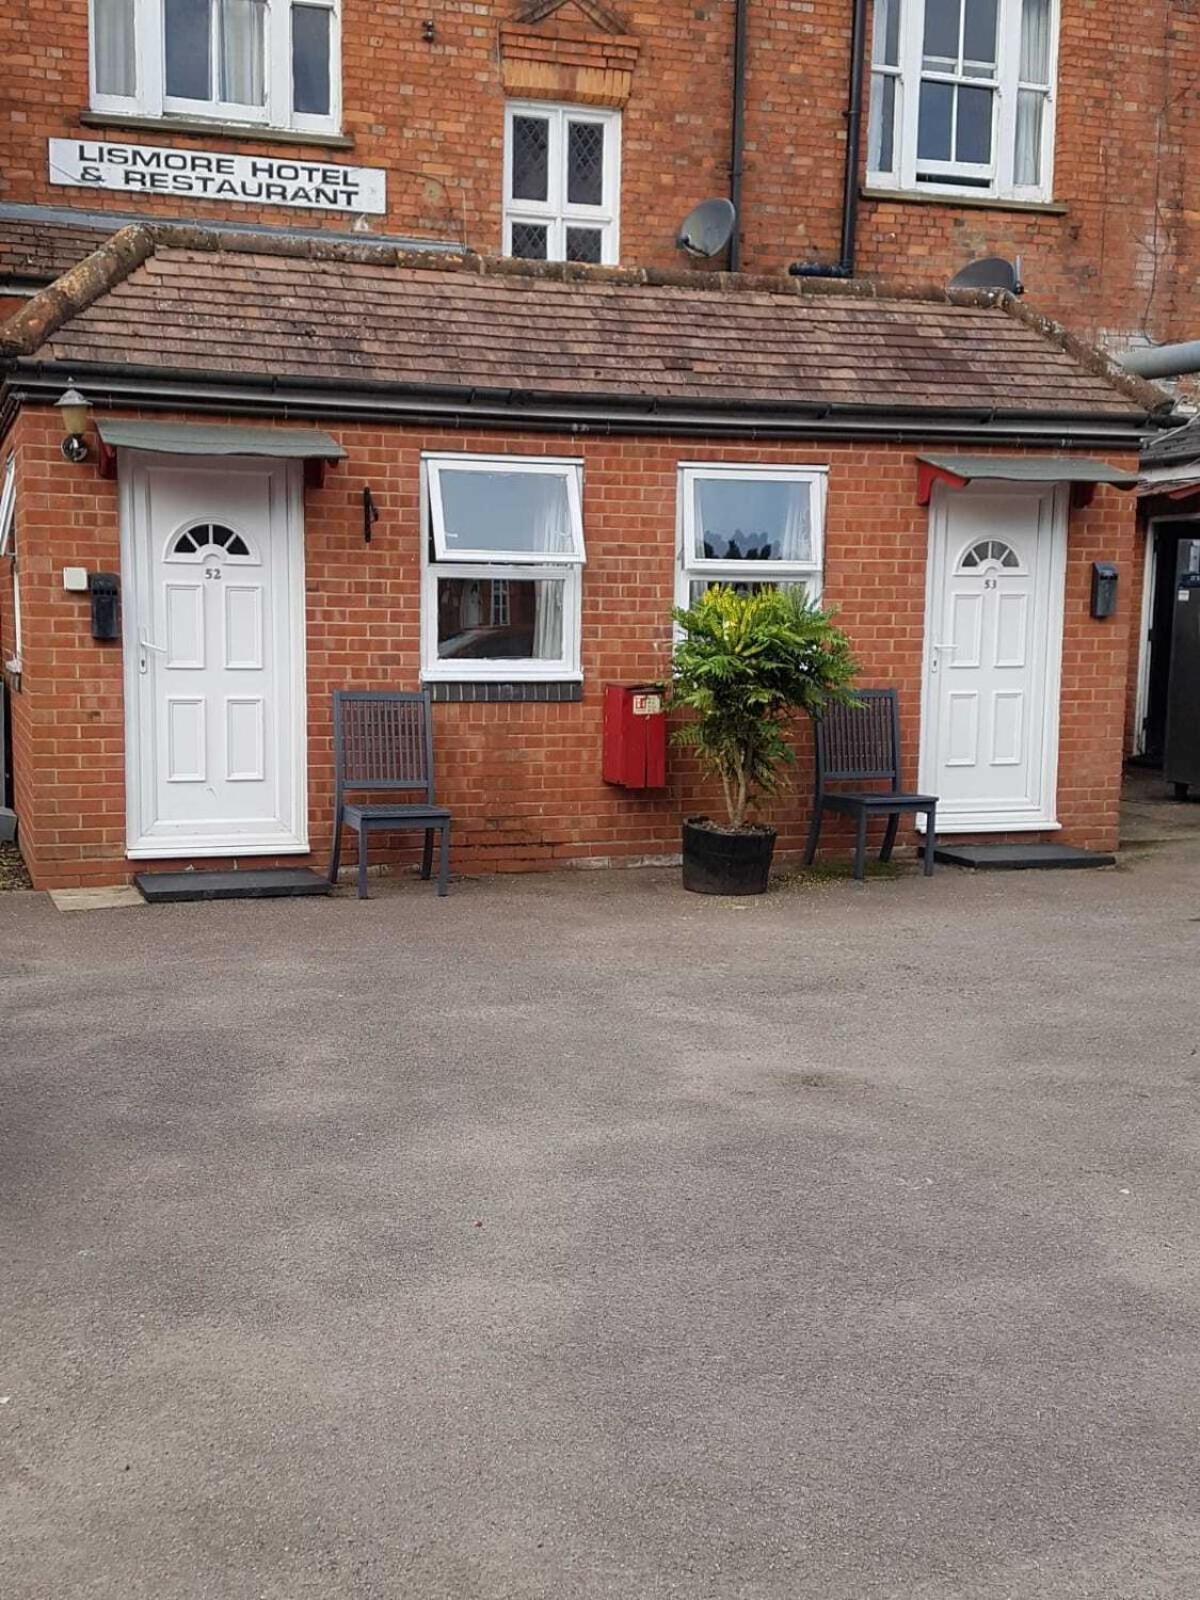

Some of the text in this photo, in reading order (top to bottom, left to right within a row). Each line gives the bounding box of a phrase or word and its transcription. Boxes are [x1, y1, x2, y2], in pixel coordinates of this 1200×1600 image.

[78, 144, 359, 187] LISMORE HOTEL
[80, 166, 359, 206] & RESTAURANT
[204, 567, 222, 580] 52
[983, 579, 997, 590] 53
